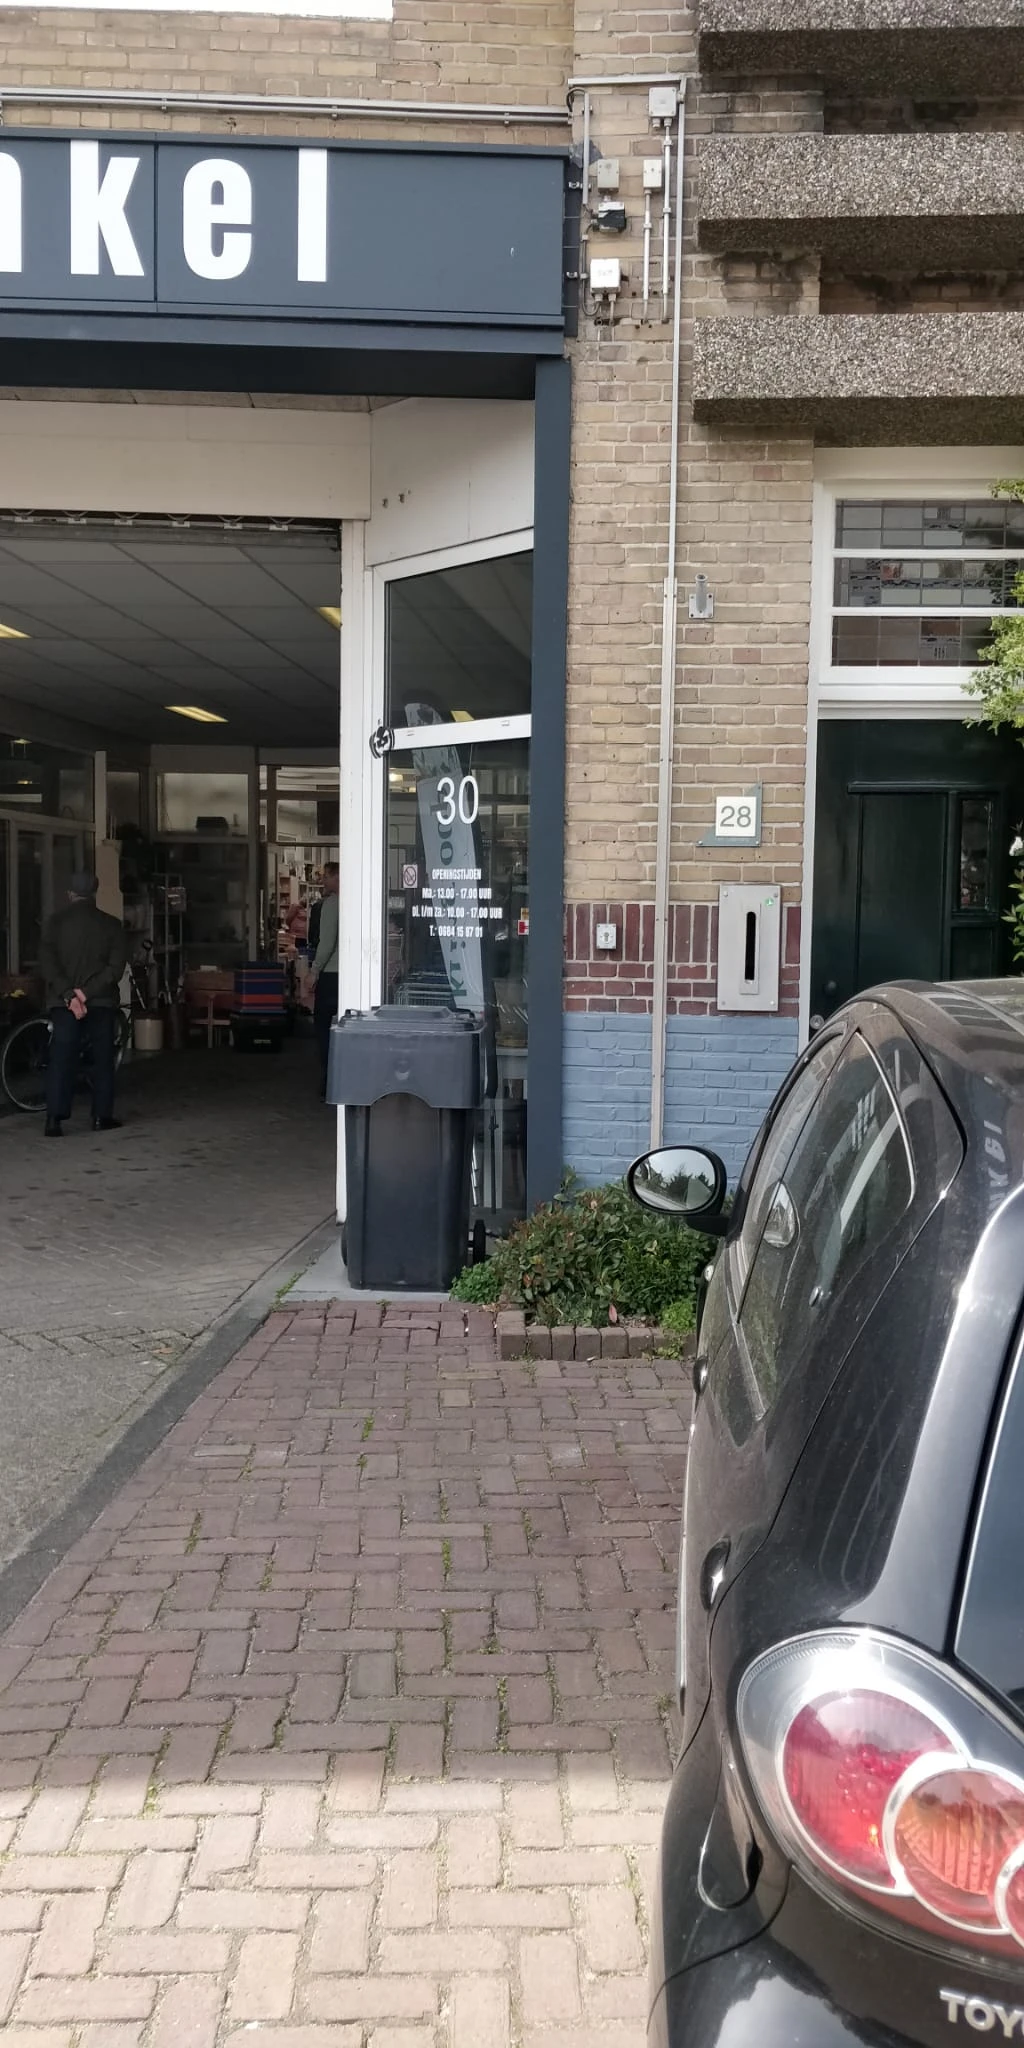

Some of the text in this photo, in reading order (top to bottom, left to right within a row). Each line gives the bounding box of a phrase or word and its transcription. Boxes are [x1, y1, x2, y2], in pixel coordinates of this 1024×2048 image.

[436, 776, 479, 825] 30
[720, 805, 752, 828] 28
[432, 868, 482, 880] OPENINGSTIJDEN
[460, 887, 478, 900] 17.00
[478, 887, 492, 900] UUR
[489, 907, 503, 919] UUR
[939, 1989, 1024, 2039] TOY
